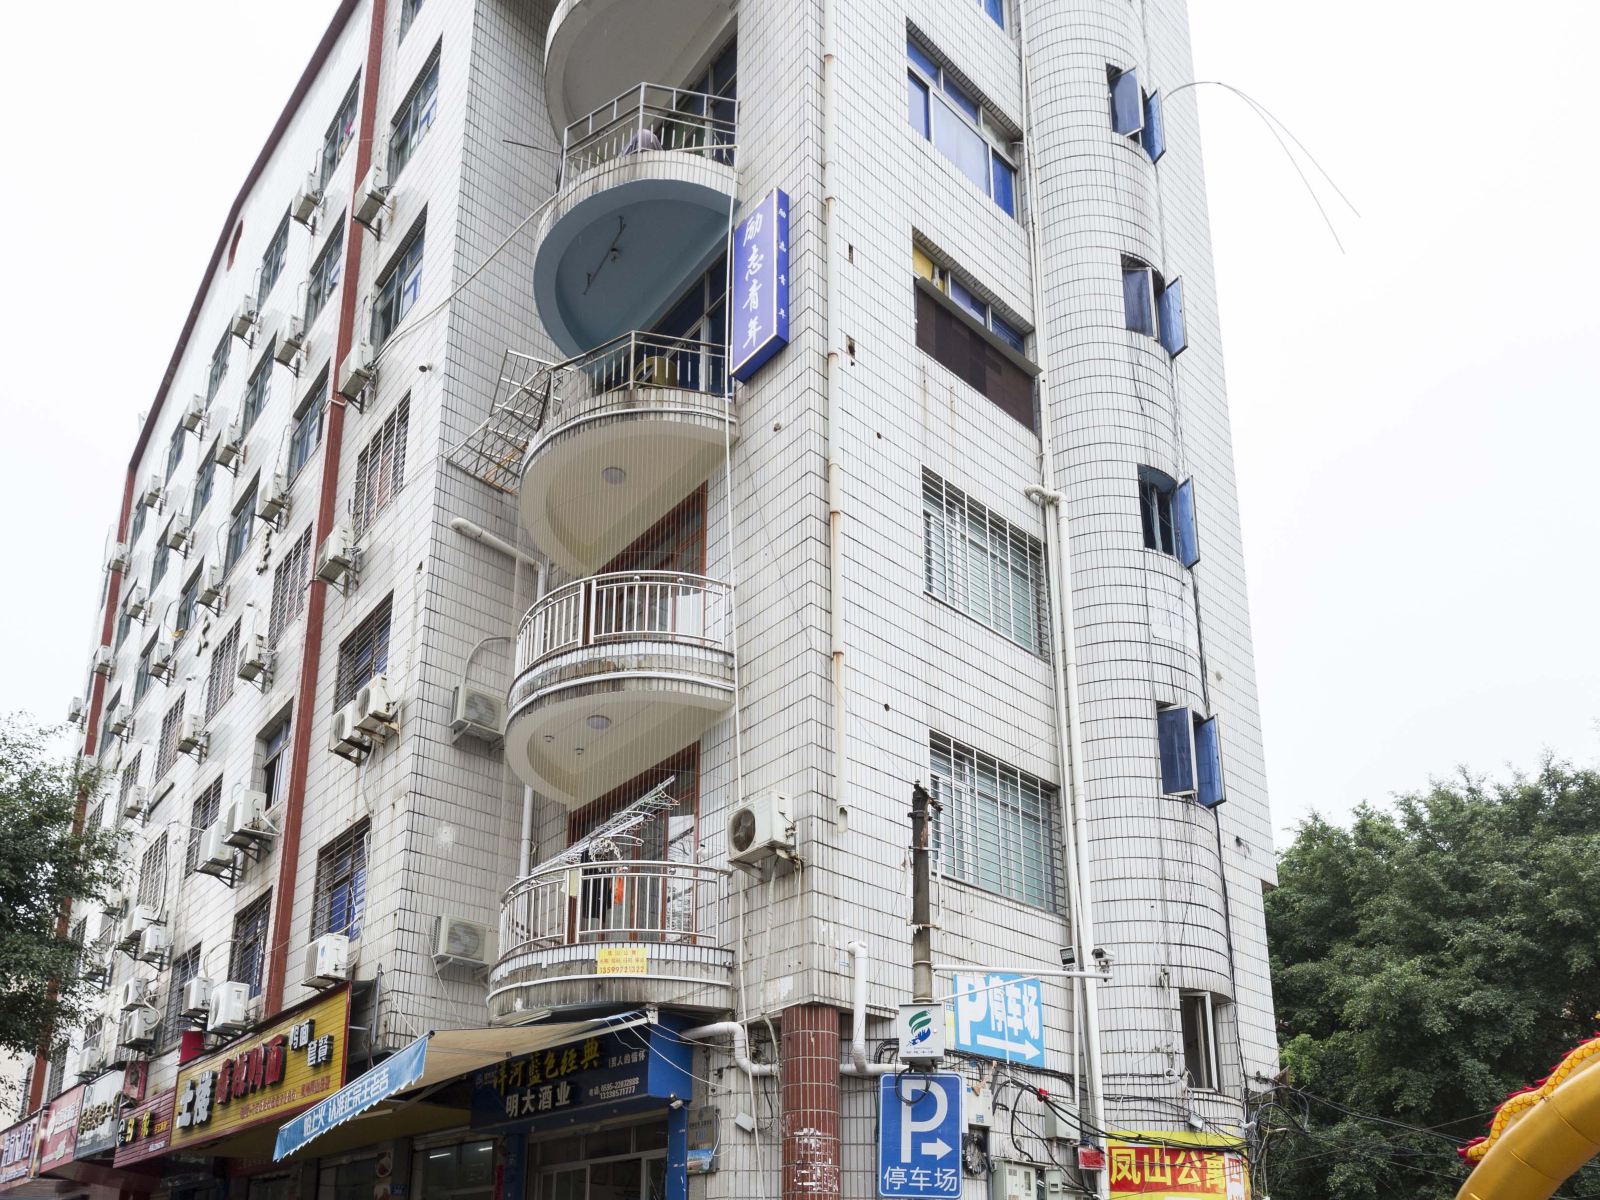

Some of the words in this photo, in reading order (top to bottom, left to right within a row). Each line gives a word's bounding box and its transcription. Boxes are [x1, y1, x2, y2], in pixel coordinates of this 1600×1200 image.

[743, 212, 764, 350] 励志青年
[957, 975, 988, 1046] P
[988, 975, 1040, 1040] 停车场
[505, 1081, 572, 1118] 明大酒业
[900, 1079, 949, 1164] P
[883, 1165, 958, 1193] 停车场
[1110, 1148, 1226, 1189] 凤山公寓
